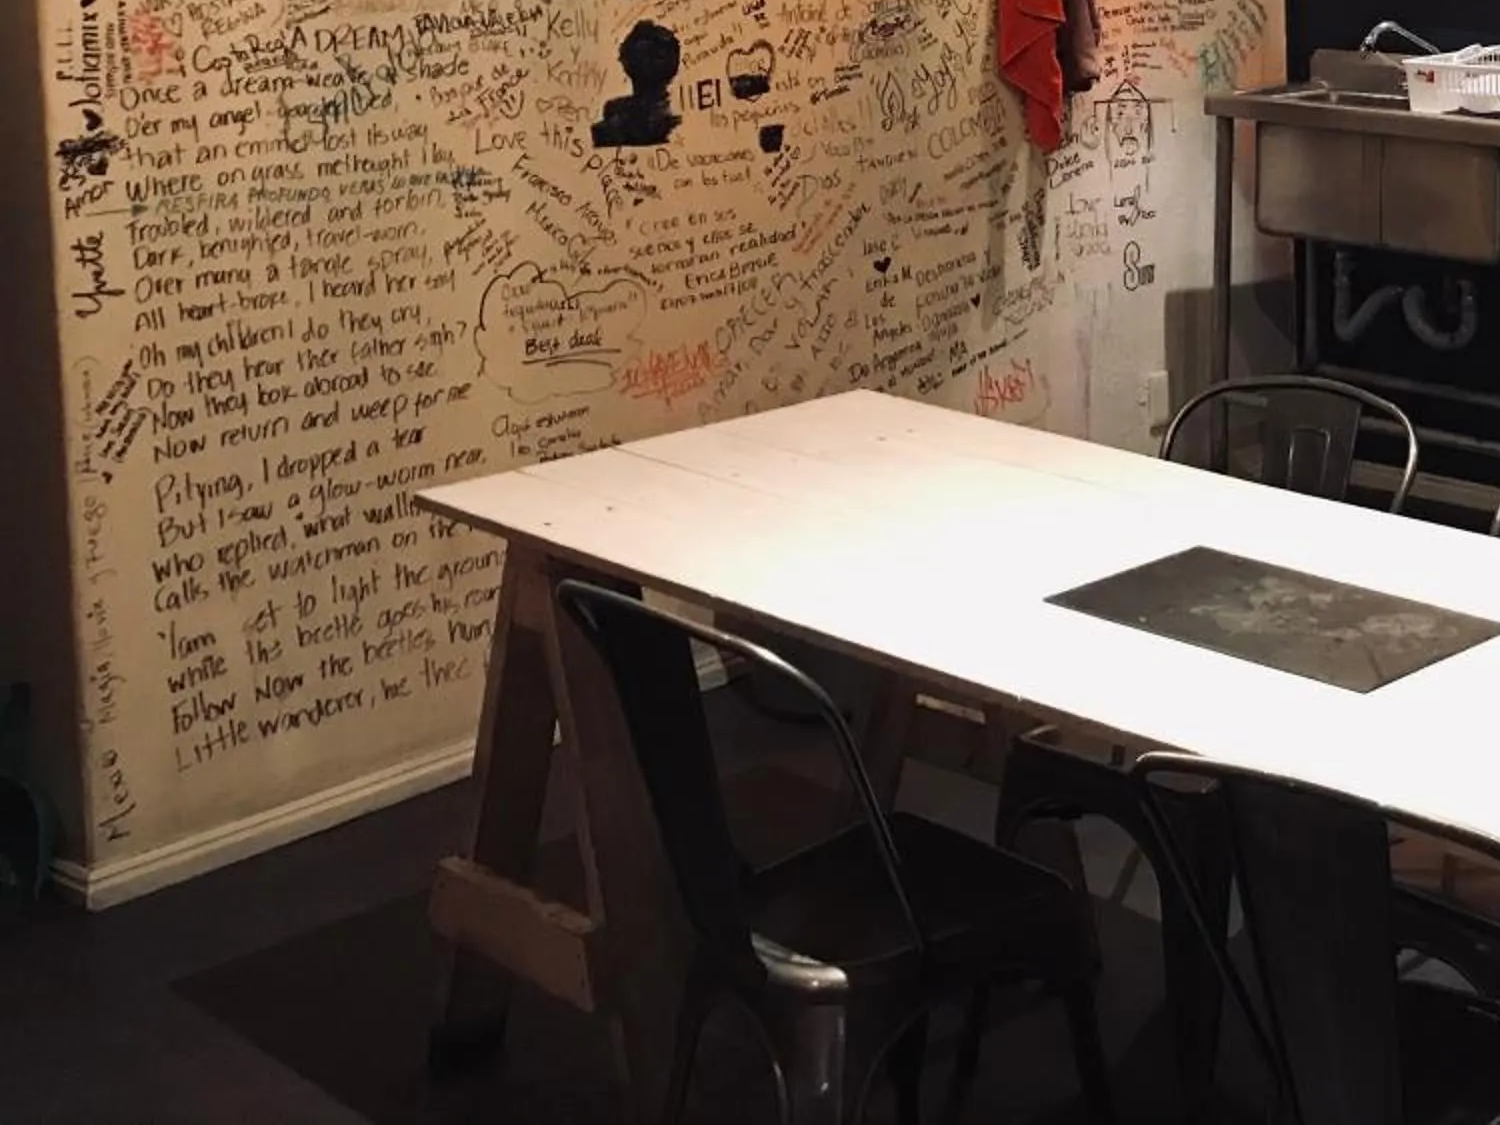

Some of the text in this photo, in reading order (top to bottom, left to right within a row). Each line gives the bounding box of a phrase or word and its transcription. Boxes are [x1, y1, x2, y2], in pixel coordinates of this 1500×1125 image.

[315, 23, 404, 53] DREAM
[120, 85, 183, 111] Once
[196, 139, 228, 163] an
[475, 121, 585, 158] Love this
[125, 172, 202, 203] Where
[217, 167, 245, 186] on
[327, 198, 362, 223] and
[133, 275, 184, 303] Over
[134, 272, 417, 333] All heard her
[138, 343, 168, 370] Oh
[524, 331, 561, 356] Best
[147, 375, 175, 400] Do
[183, 368, 236, 395] they
[152, 402, 195, 434] Now
[204, 389, 249, 417] they
[153, 437, 207, 464] Now
[301, 405, 341, 433] and
[277, 443, 357, 478] dropped
[156, 511, 208, 548] But
[151, 552, 205, 581] Who
[253, 674, 305, 704] Now
